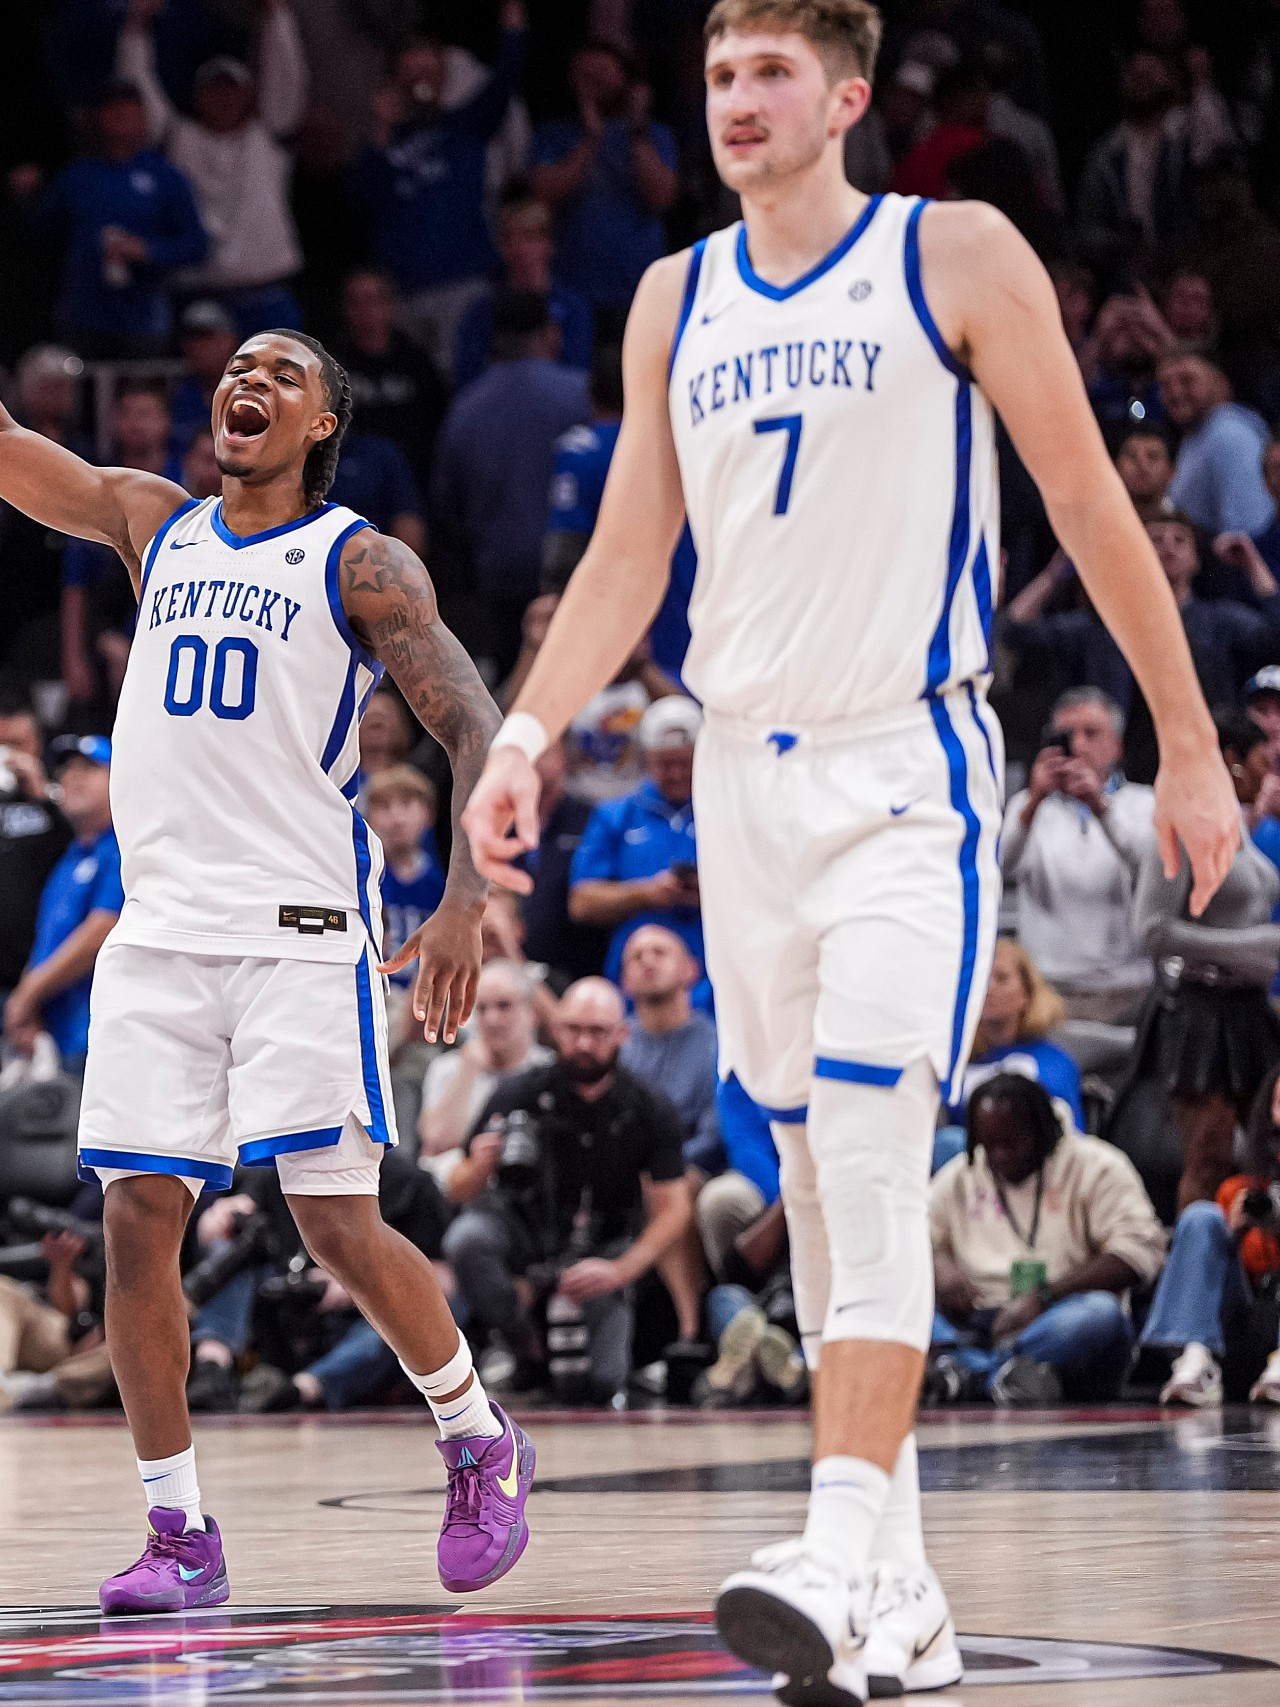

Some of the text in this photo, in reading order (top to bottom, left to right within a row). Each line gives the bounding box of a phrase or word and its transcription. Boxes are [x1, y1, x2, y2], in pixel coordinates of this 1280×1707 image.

[688, 339, 882, 427] KENTUCKY
[753, 413, 803, 517] 7
[285, 549, 305, 565] SEC
[149, 580, 301, 642] KENTUCKY
[163, 634, 259, 721] 00
[328, 915, 339, 925] 46
